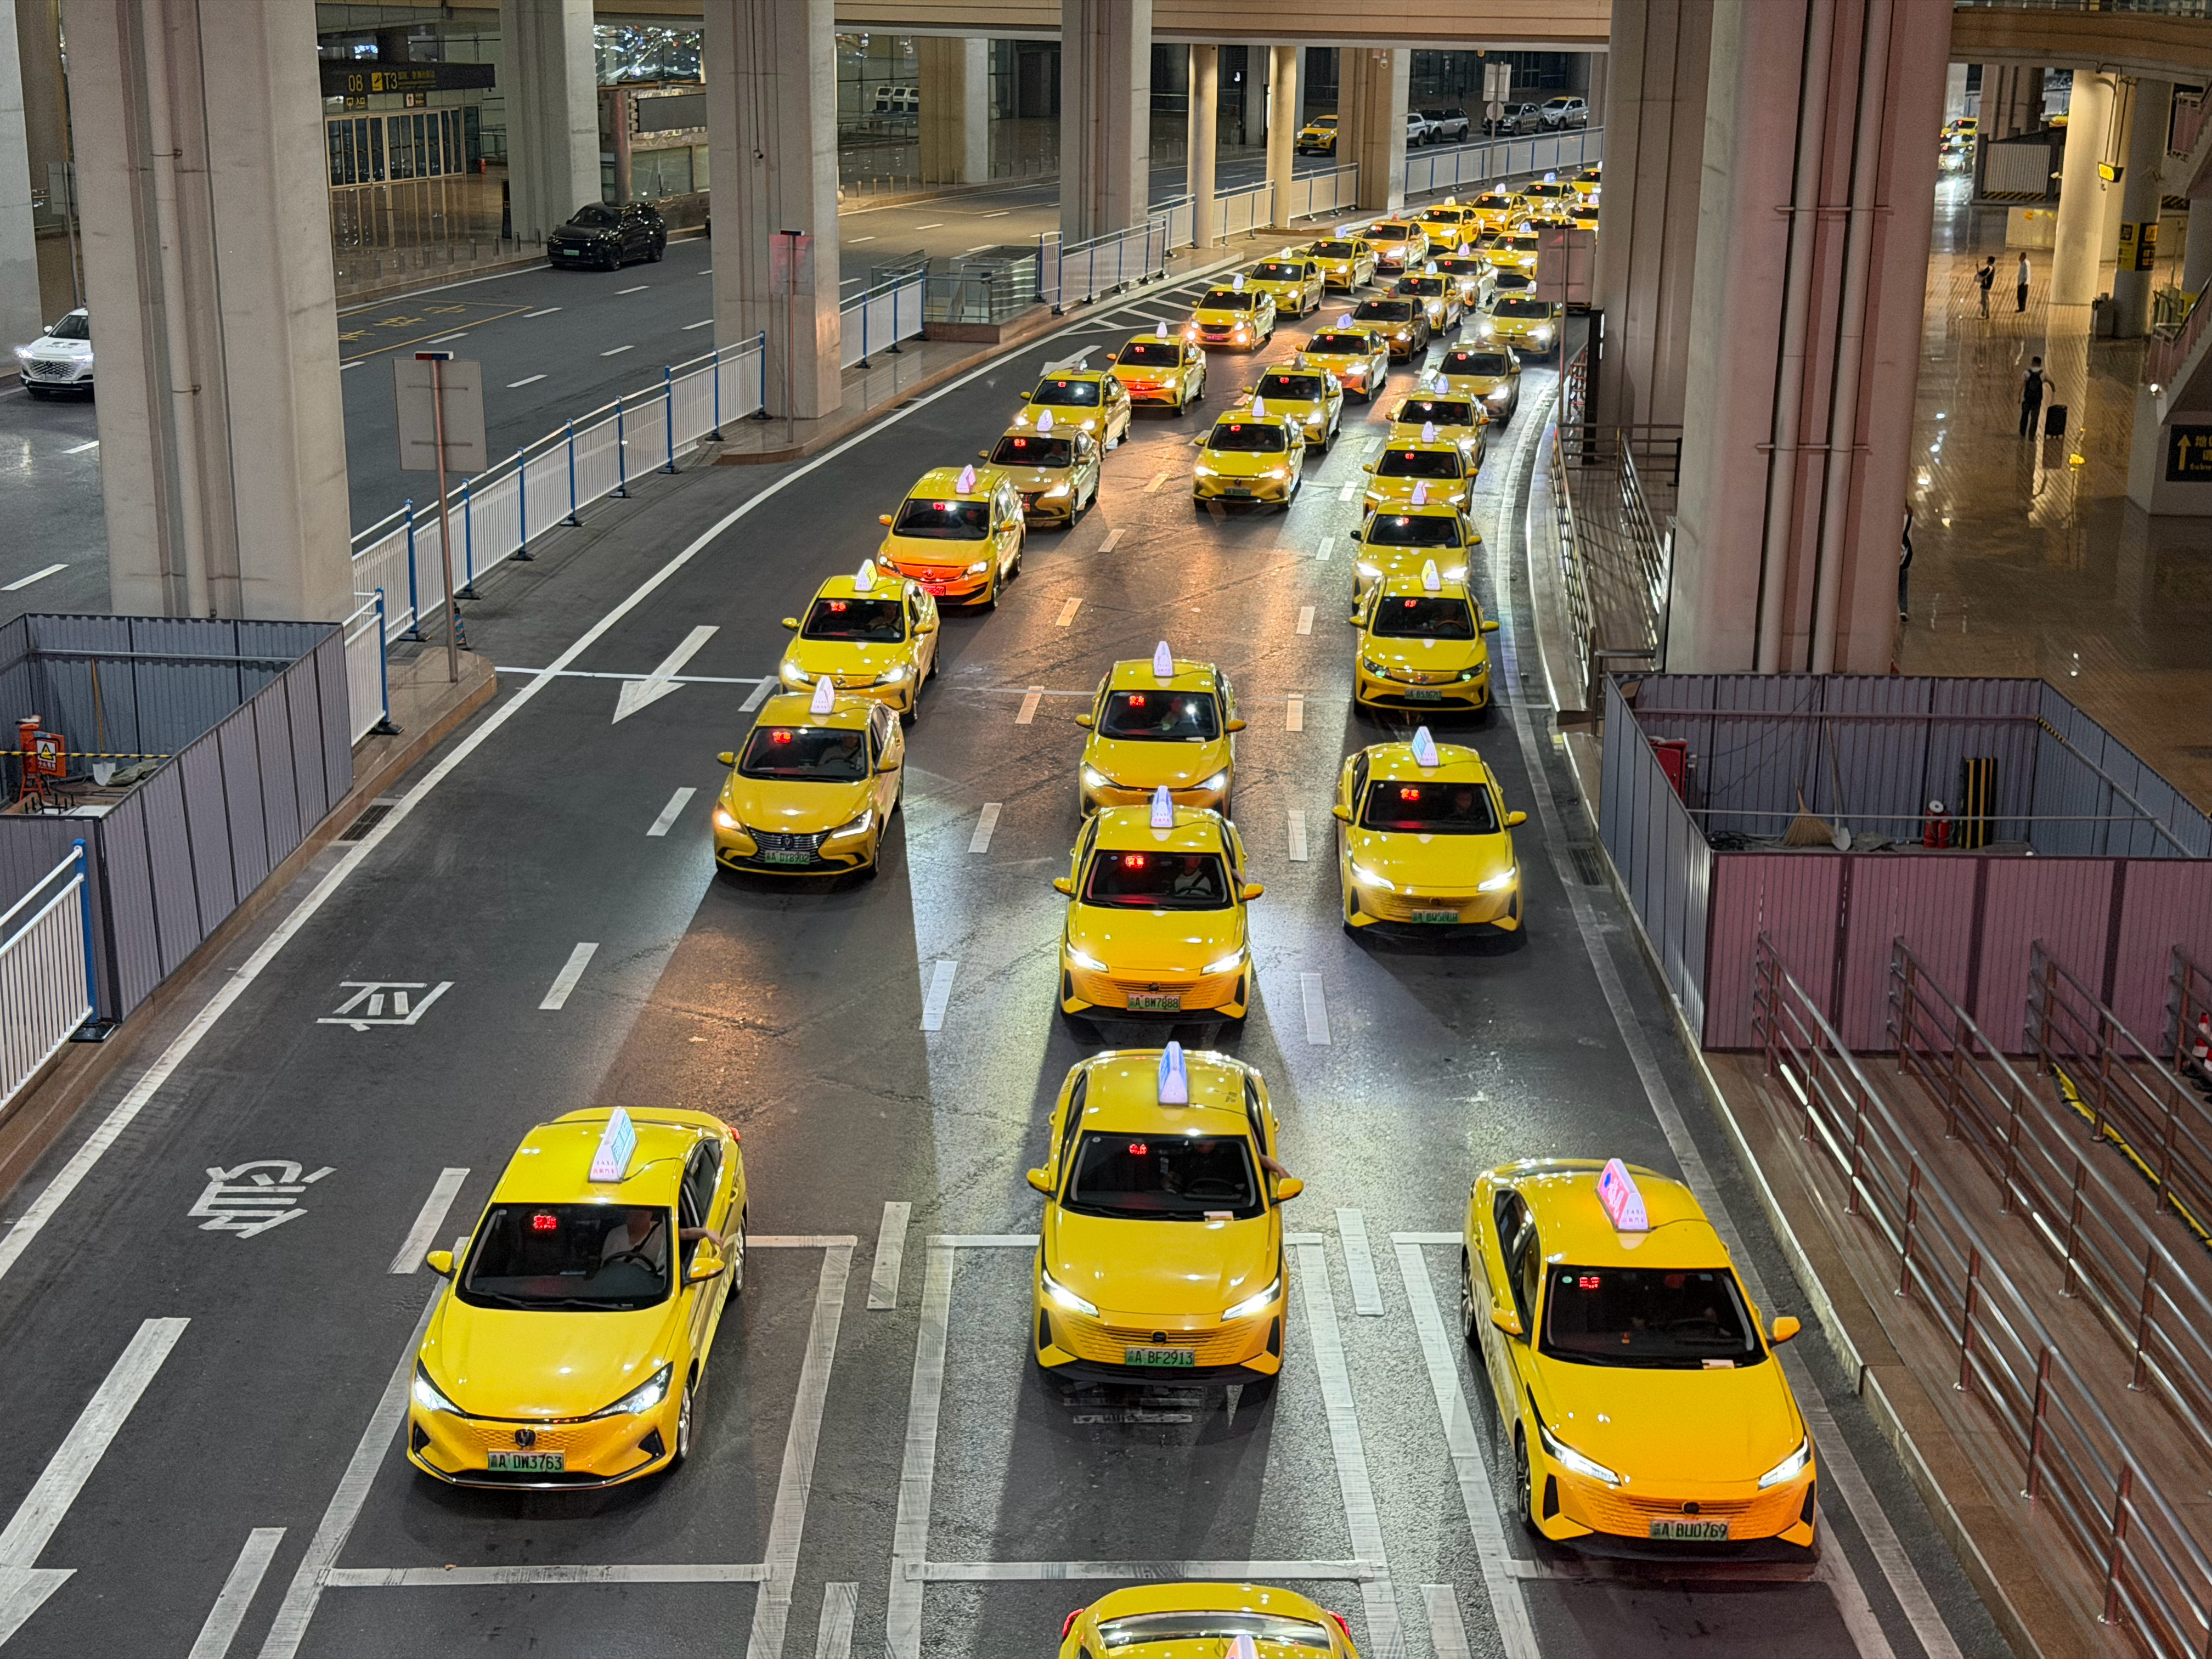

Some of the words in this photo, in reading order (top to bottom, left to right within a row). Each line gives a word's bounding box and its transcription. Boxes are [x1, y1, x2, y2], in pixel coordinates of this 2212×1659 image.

[348, 75, 363, 92] 08
[383, 72, 398, 90] T3
[1148, 1351, 1193, 1365] BF2913
